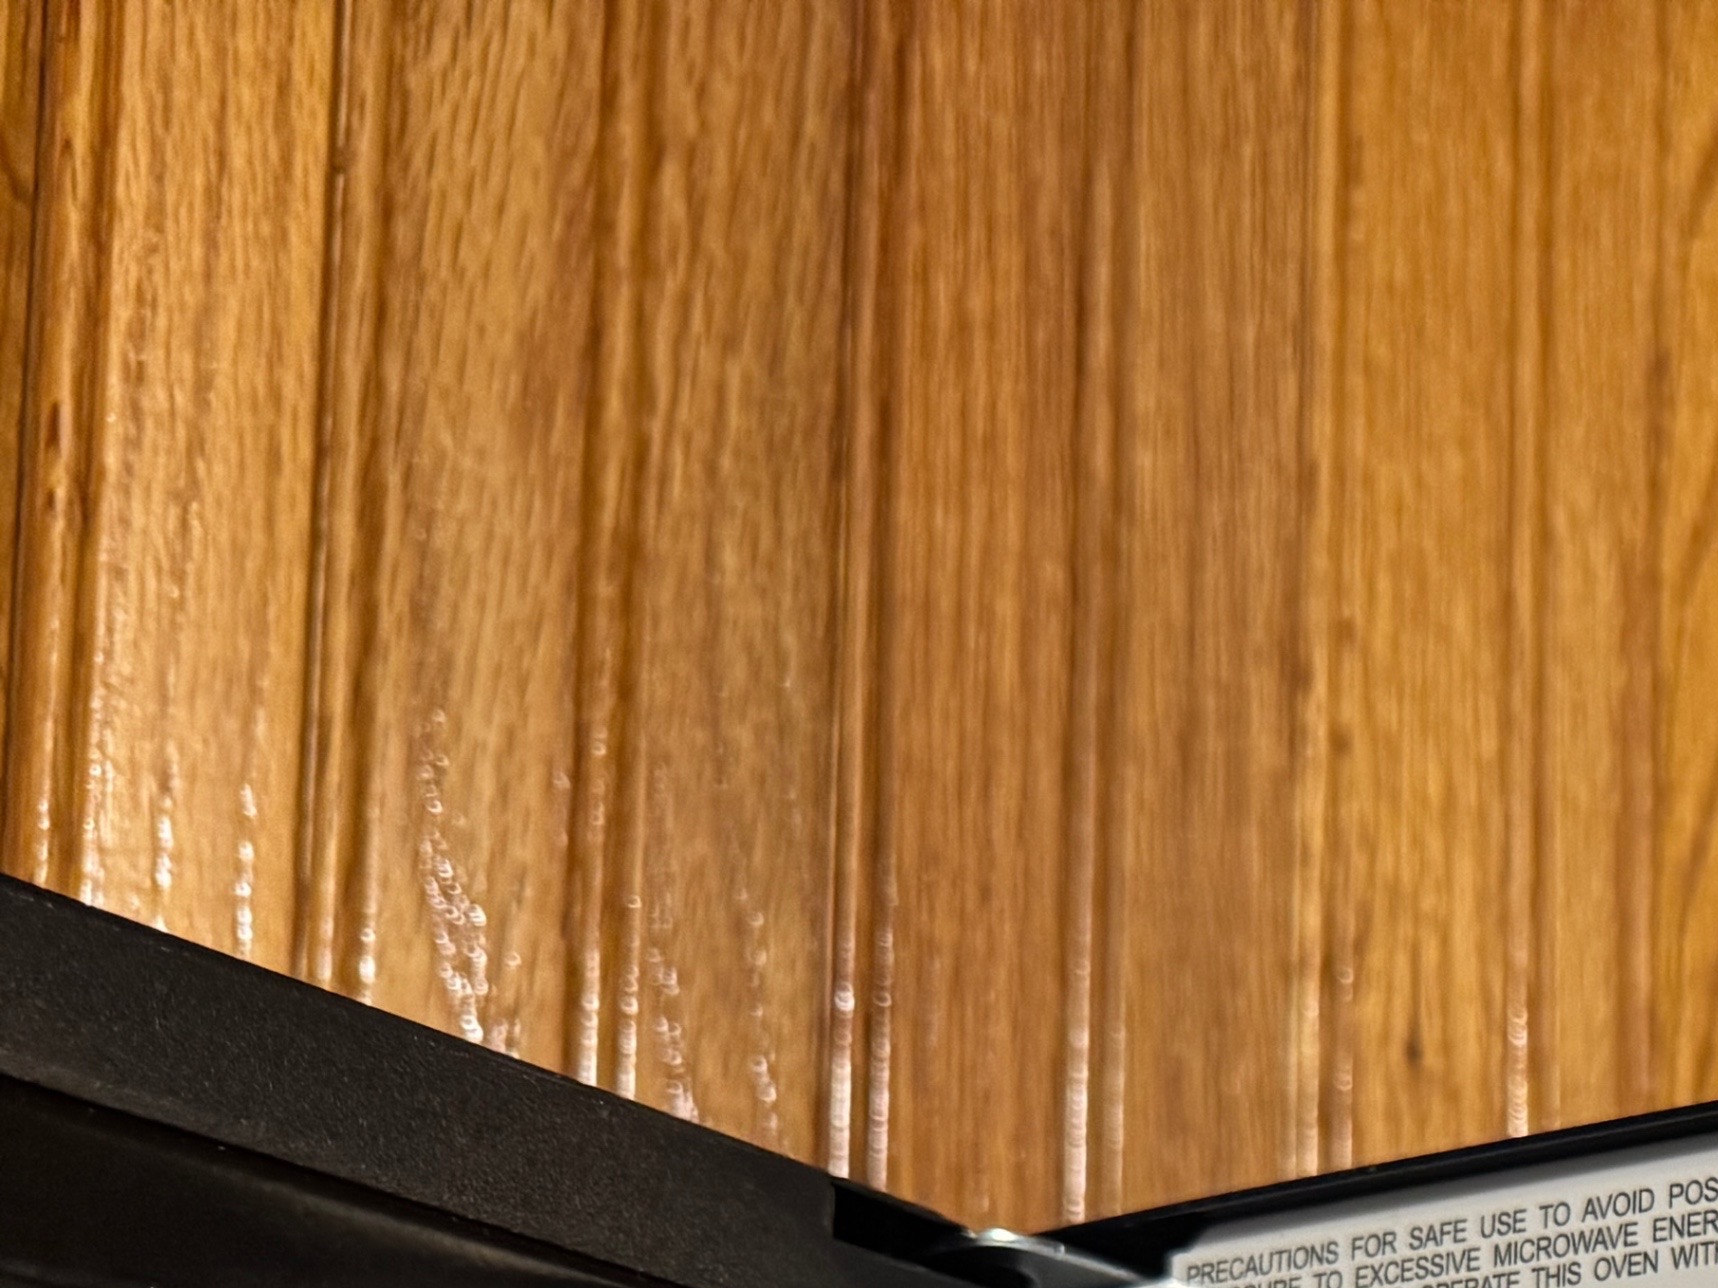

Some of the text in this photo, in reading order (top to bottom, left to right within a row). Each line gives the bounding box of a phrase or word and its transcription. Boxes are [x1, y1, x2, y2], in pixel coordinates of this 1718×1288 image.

[1185, 1240, 1340, 1284] PRECAUTIONS
[1350, 1230, 1398, 1261] FOR
[1408, 1218, 1468, 1251] SAFE
[1480, 1208, 1528, 1240] USE
[1538, 1201, 1572, 1230] TO
[1580, 1187, 1656, 1224] AVOID
[1493, 1220, 1639, 1269] MICROWAVE
[1592, 1248, 1659, 1282] OVEN
